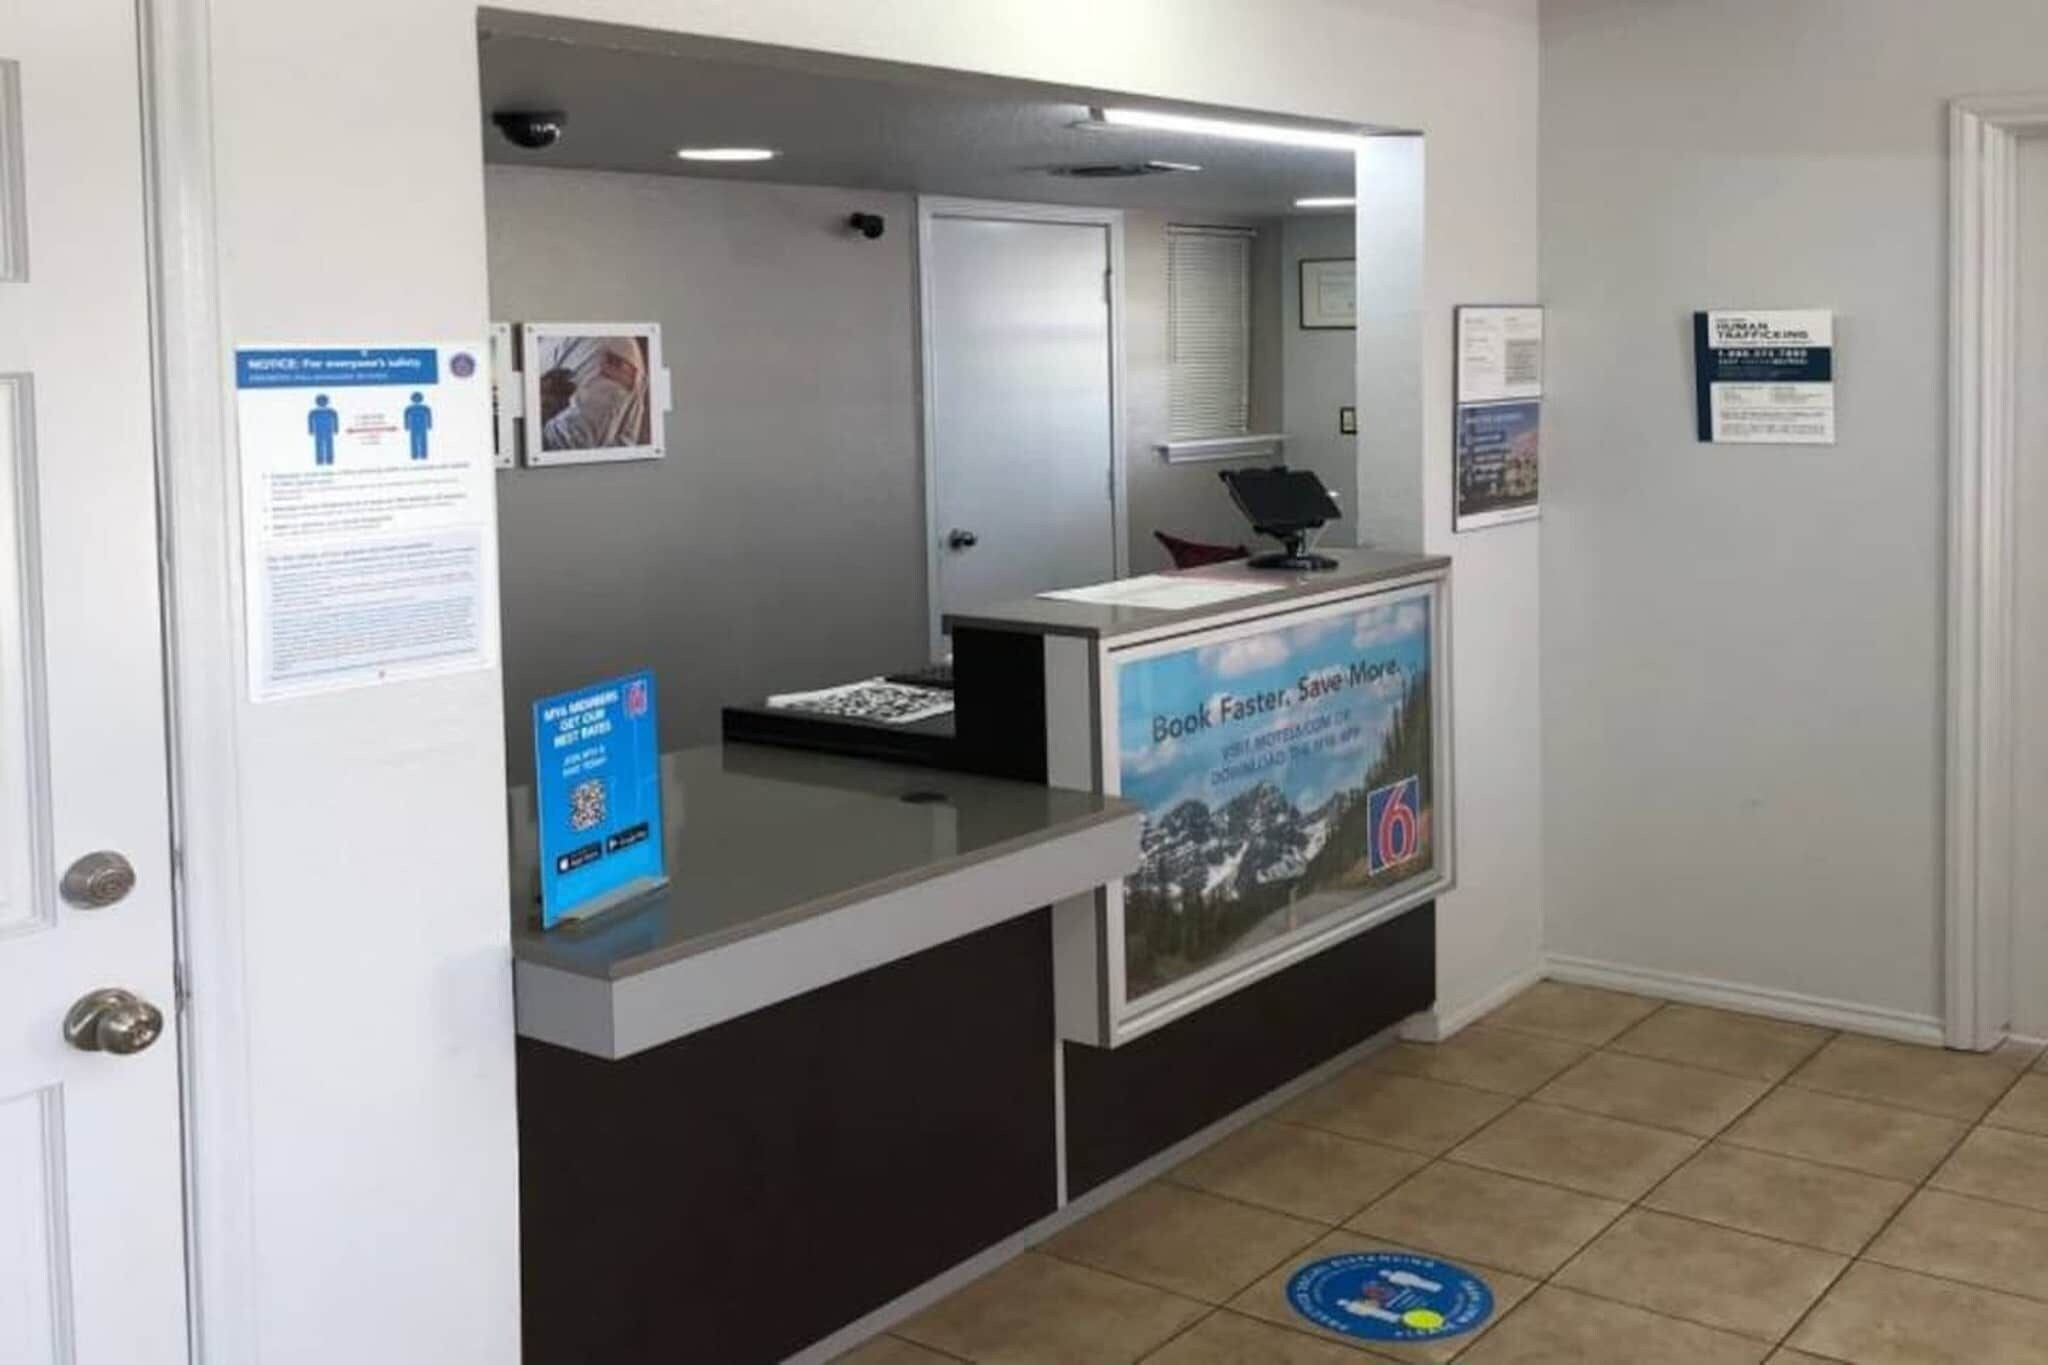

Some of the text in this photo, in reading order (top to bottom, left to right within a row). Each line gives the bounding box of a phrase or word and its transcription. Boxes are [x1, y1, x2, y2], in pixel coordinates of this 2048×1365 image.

[1717, 331, 1808, 339] TRAFFICKING
[1152, 659, 1400, 743] Book Faster. Save More.
[1377, 783, 1417, 867] 6
